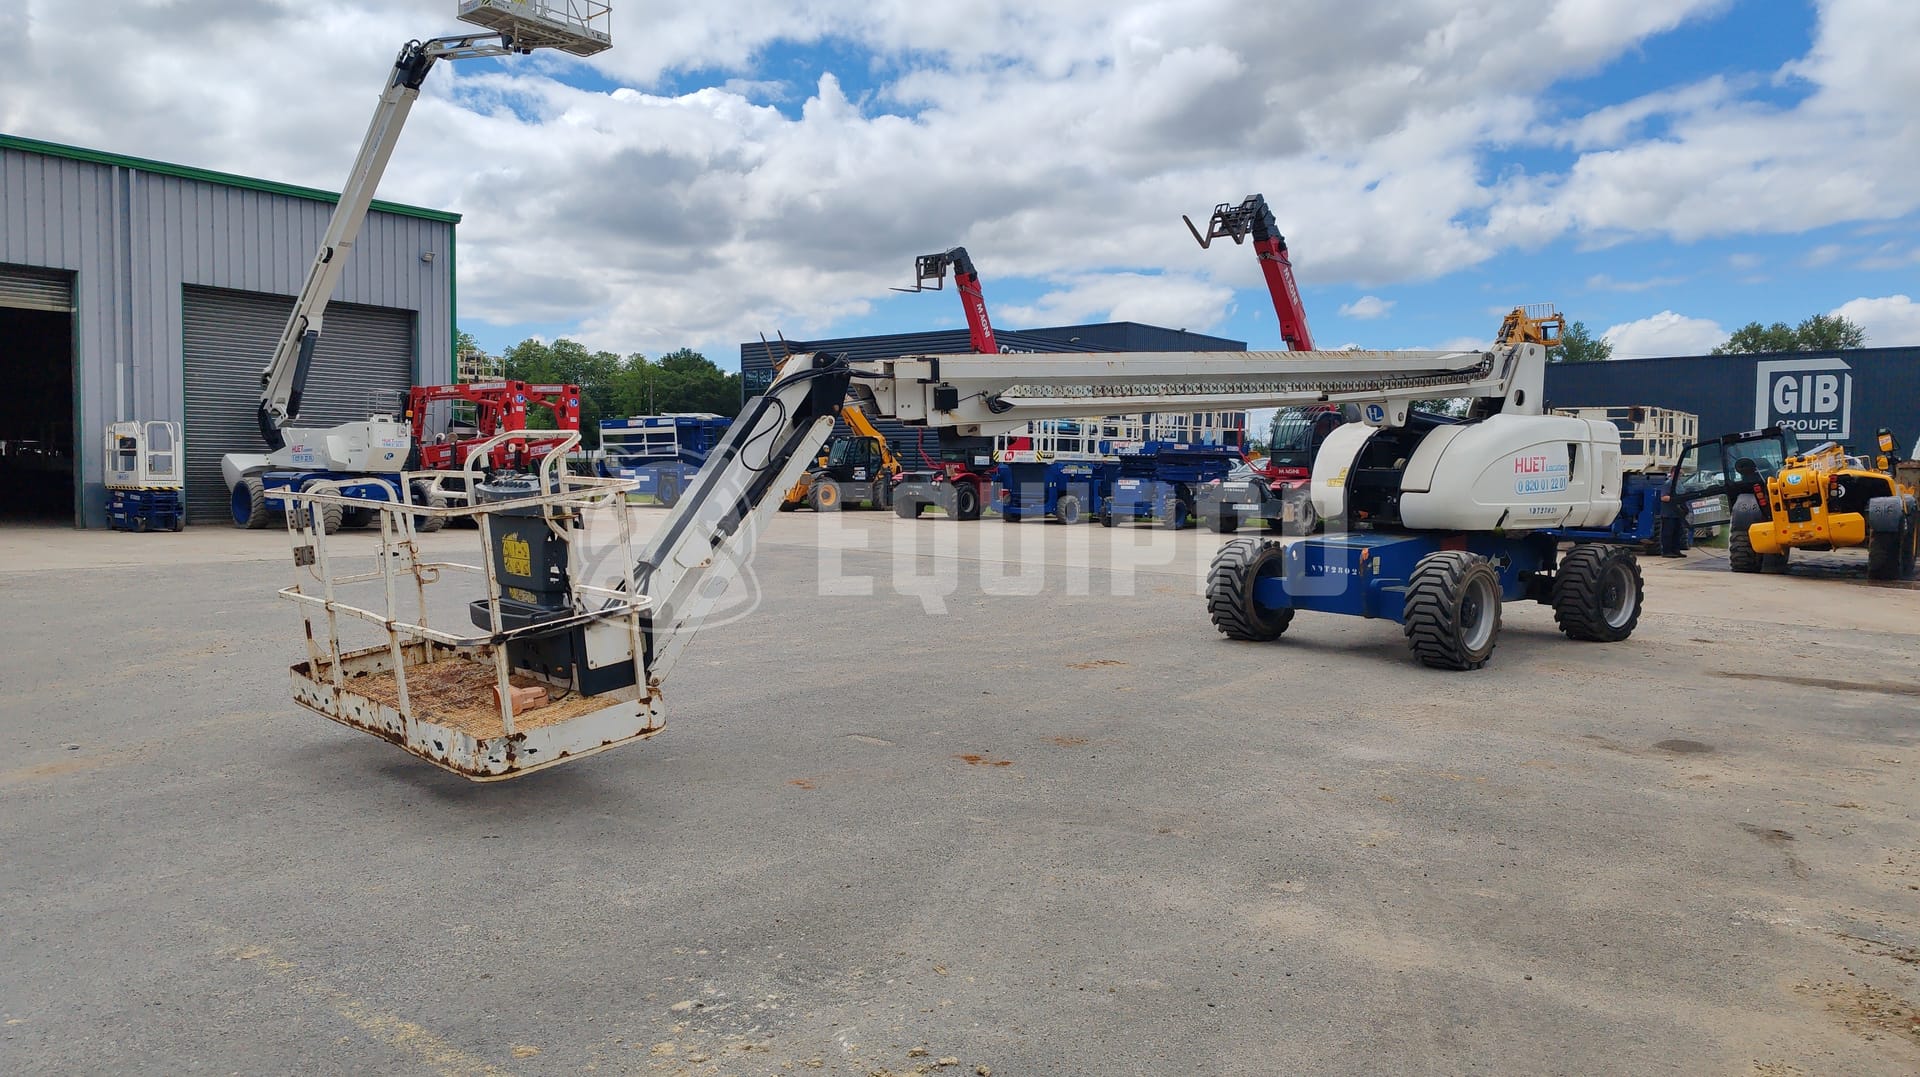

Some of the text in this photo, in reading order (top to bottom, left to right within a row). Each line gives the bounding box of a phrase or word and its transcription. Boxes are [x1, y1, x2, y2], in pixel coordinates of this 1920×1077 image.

[977, 303, 990, 338] MAGNI
[1773, 375, 1839, 414] GIB
[1515, 456, 1547, 473] HUET
[1518, 476, 1566, 492] 0 820 01 22 01
